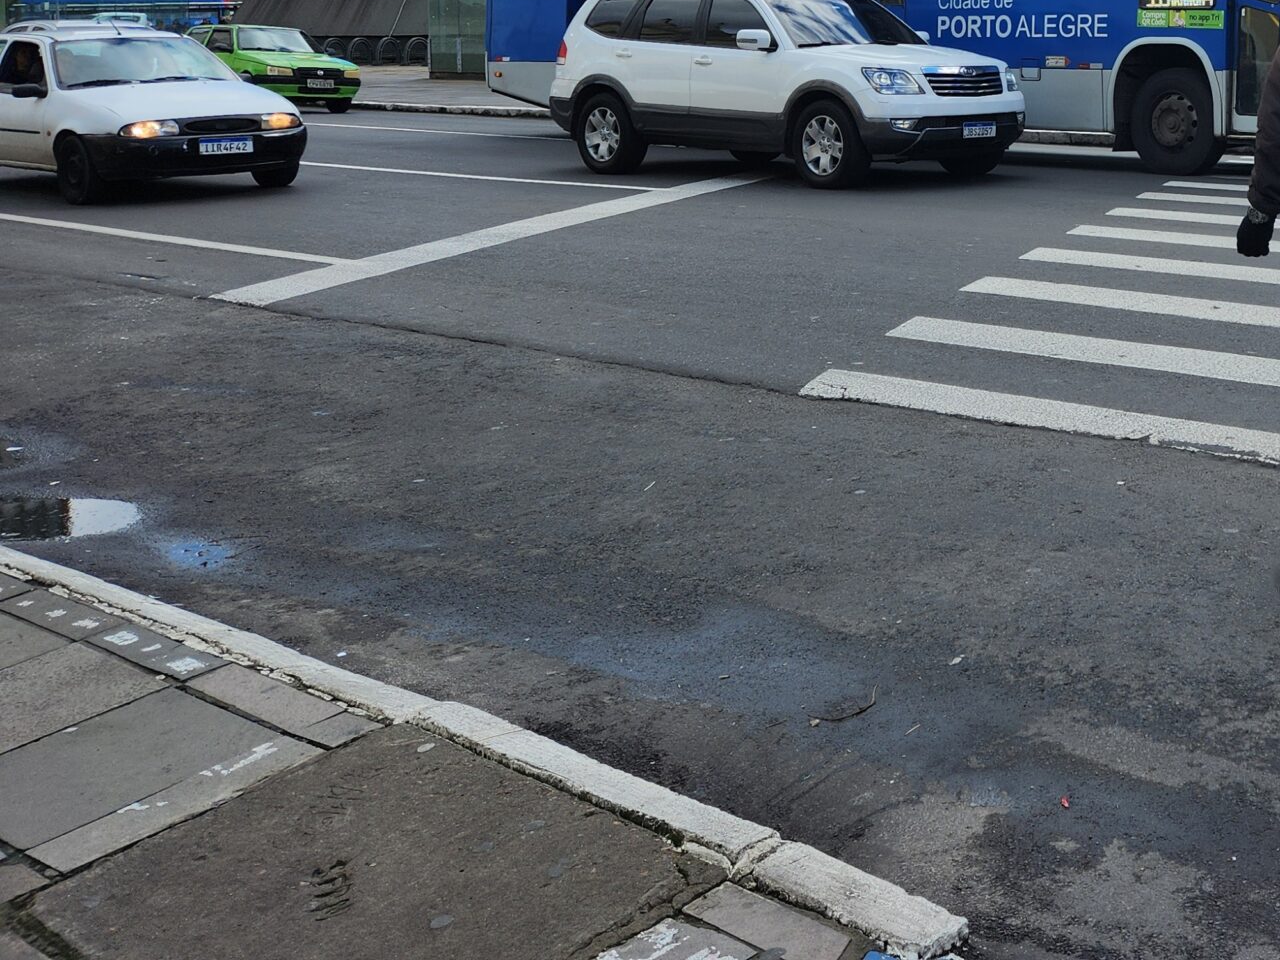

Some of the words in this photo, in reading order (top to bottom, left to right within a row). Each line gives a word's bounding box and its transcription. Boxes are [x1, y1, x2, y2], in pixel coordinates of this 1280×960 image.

[1189, 13, 1197, 21] no
[937, 15, 1012, 38] PORTO
[1015, 14, 1108, 38] ALEGRE
